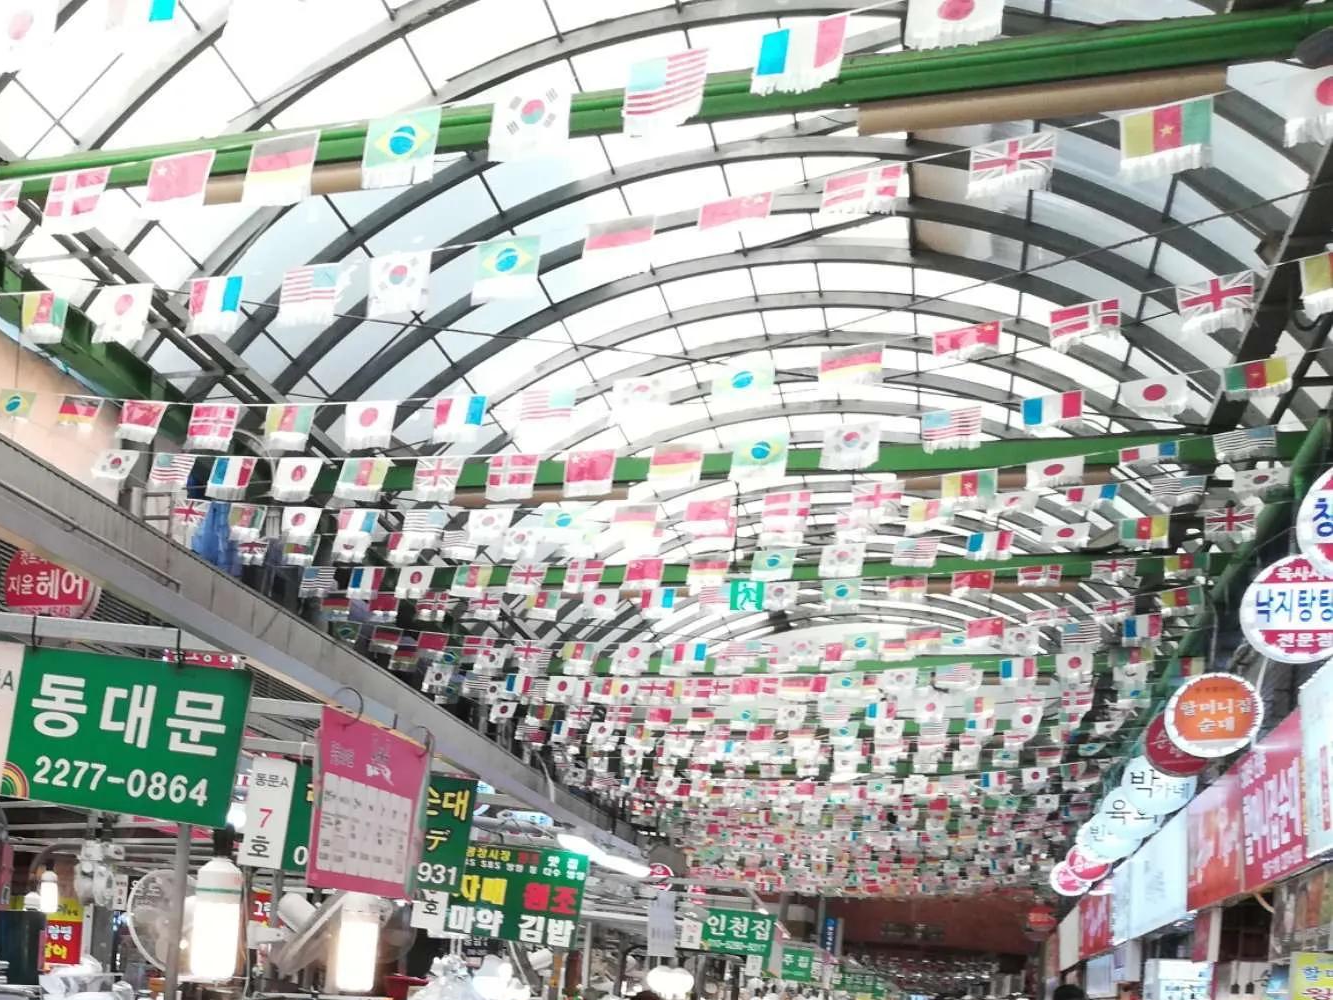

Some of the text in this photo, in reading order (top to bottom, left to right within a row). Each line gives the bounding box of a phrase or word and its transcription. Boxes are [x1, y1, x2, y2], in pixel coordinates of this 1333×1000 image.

[31, 673, 226, 757] 동대문
[32, 755, 210, 808] 2277-0864
[259, 807, 273, 829] 7
[247, 836, 271, 860] 호
[448, 904, 576, 948] 마약 김밥
[706, 914, 772, 941] 인천집
